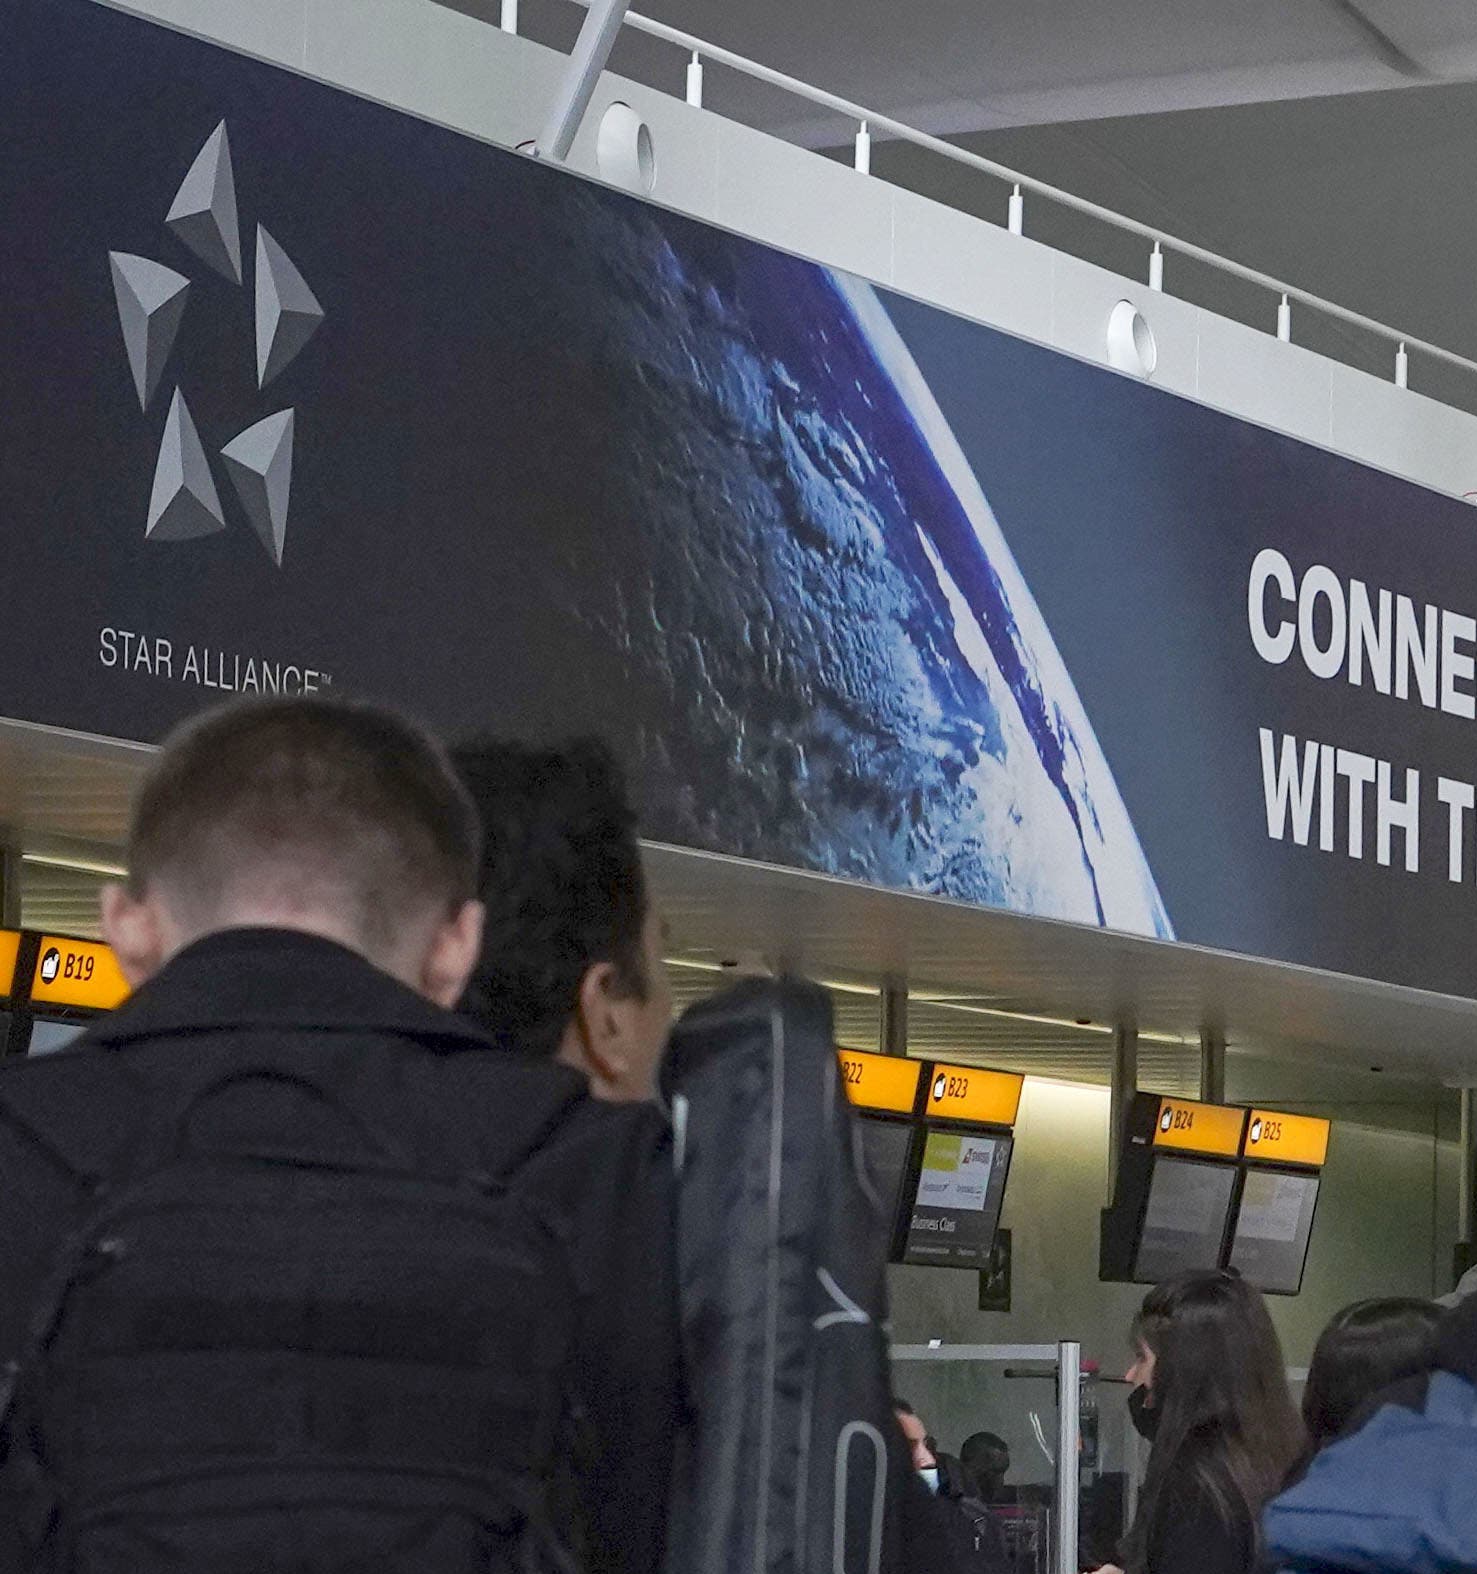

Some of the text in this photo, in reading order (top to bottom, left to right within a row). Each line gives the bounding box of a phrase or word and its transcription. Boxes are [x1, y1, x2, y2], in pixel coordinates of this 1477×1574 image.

[99, 627, 172, 679] STAR
[1259, 727, 1419, 873] WITH
[63, 952, 95, 981] B19
[947, 1077, 968, 1098] B23
[1173, 1109, 1194, 1131] B24
[1263, 1120, 1282, 1141] B25
